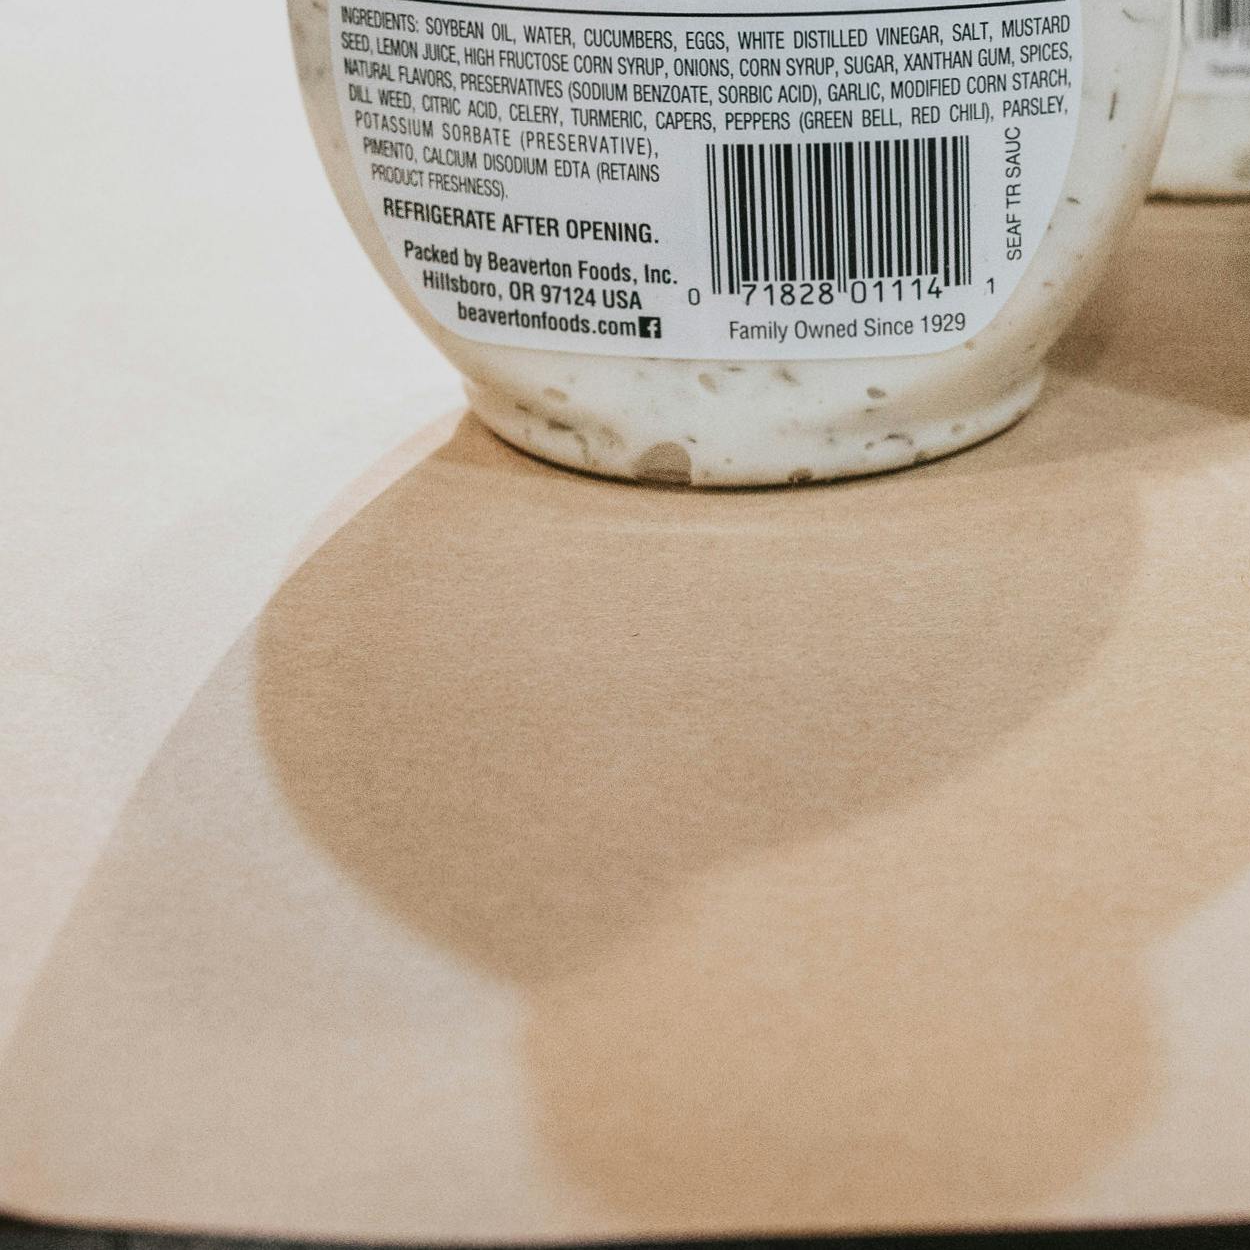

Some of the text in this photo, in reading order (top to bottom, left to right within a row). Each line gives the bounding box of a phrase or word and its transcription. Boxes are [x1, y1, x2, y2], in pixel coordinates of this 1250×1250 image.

[341, 6, 1070, 53] INGREDIENTS: SOYBEAN OIL, WATER, CUCUMBERS, EGGS, WHITE DISTILLED VINEGAR, SALT, MUSTARD
[1005, 127, 1022, 261] SEAF TR SAUC
[383, 197, 659, 244] REFRIGERATE AFTER OPENING.
[404, 240, 677, 285] Packed by Beaverton Foods, Inc.
[423, 270, 642, 310] Hillsboro, OR 97124 USA
[688, 277, 995, 306] 0 71828 01114 1
[458, 301, 636, 336] beavertonfoods.com
[730, 313, 965, 343] Family Owned Since 1929
